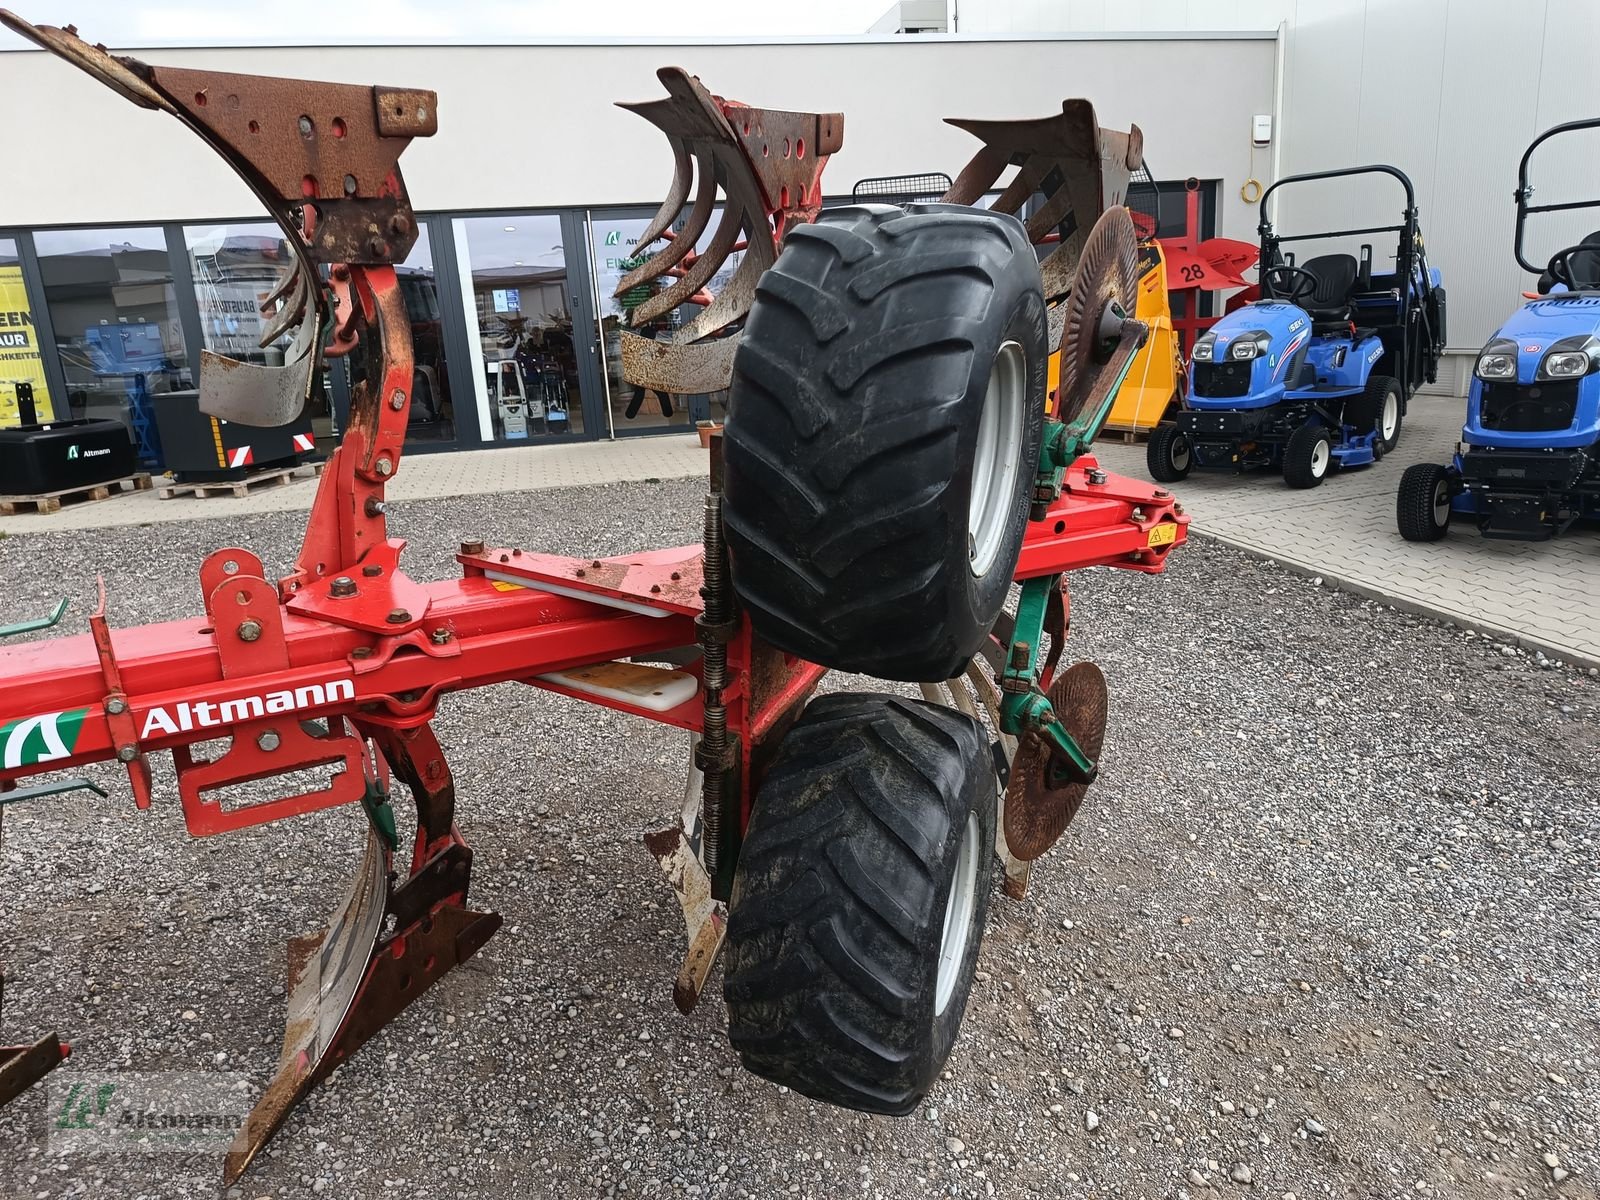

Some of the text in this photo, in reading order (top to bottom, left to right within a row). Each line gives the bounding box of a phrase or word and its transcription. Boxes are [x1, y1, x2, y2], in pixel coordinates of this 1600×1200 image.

[1181, 264, 1205, 282] 28
[1288, 317, 1304, 333] ISEKI
[84, 449, 110, 457] Altmann
[141, 679, 354, 738] Altmann
